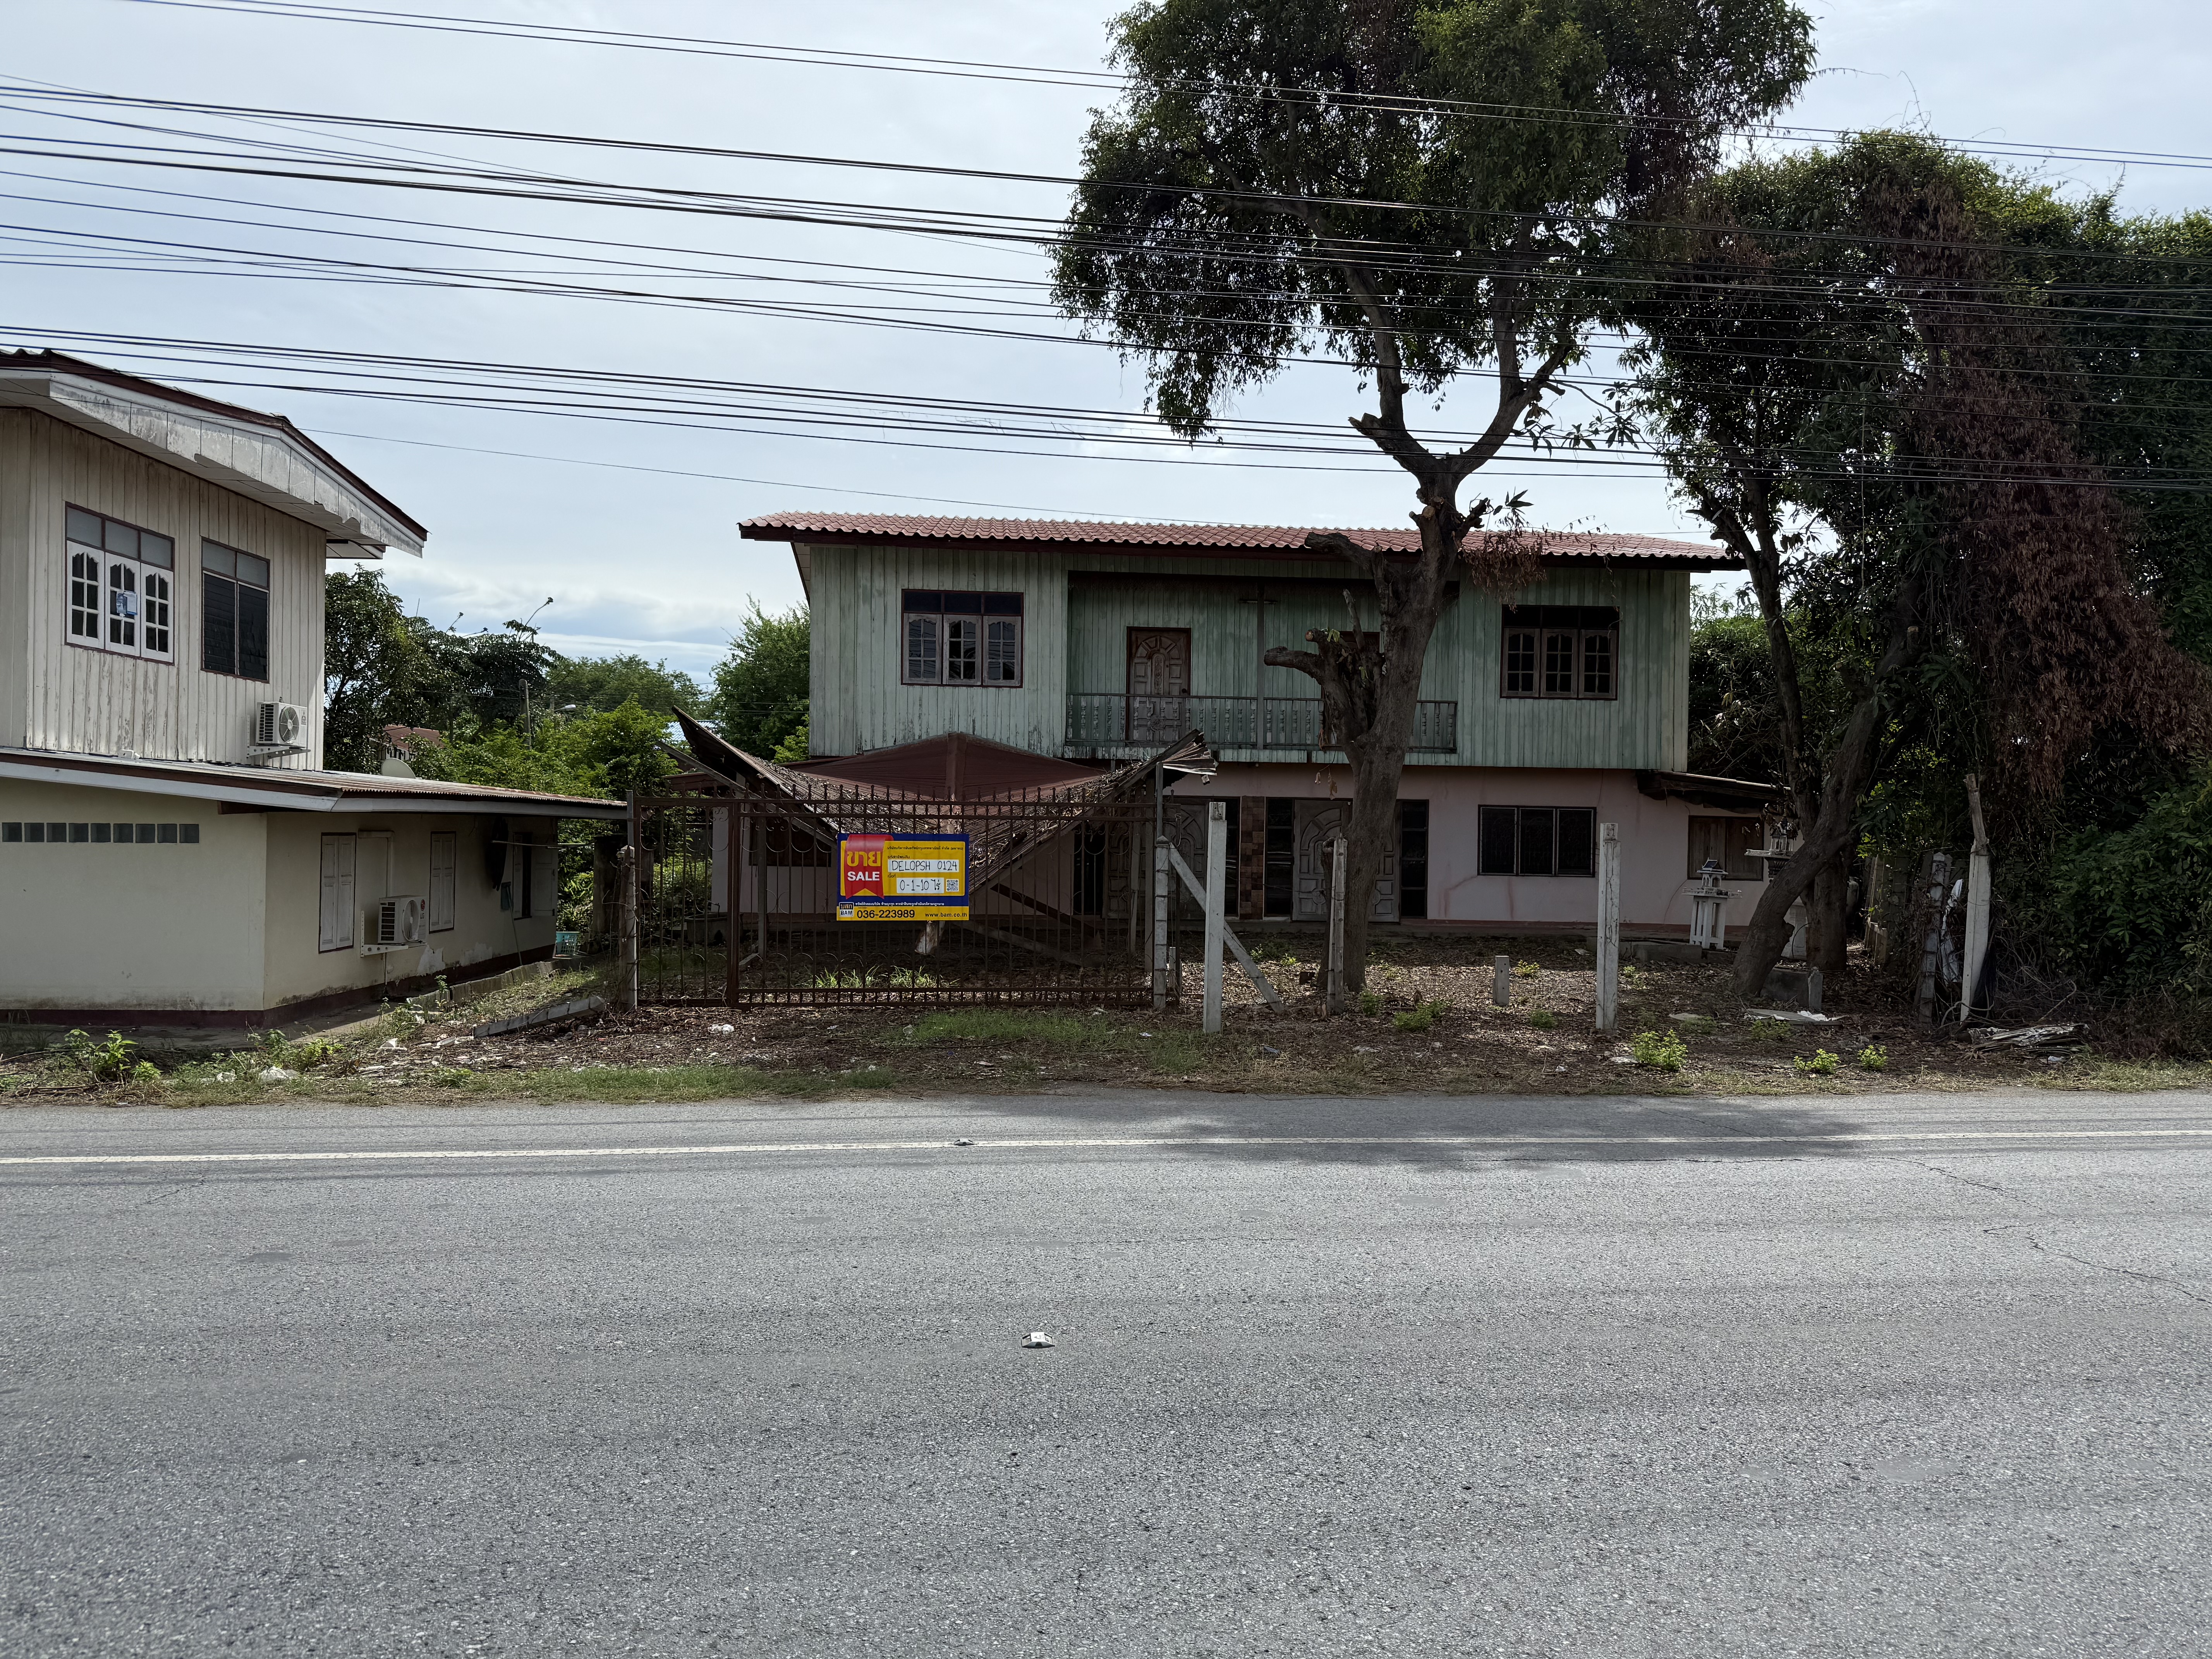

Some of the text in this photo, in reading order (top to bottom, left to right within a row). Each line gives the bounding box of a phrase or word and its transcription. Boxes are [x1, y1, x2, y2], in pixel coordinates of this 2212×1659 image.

[847, 851, 881, 867] ขาย
[892, 860, 957, 871] DELOPSH 0124
[847, 871, 880, 881] SALE
[900, 879, 941, 891] 0-1-10 ไร่
[857, 910, 915, 918] 036-223989
